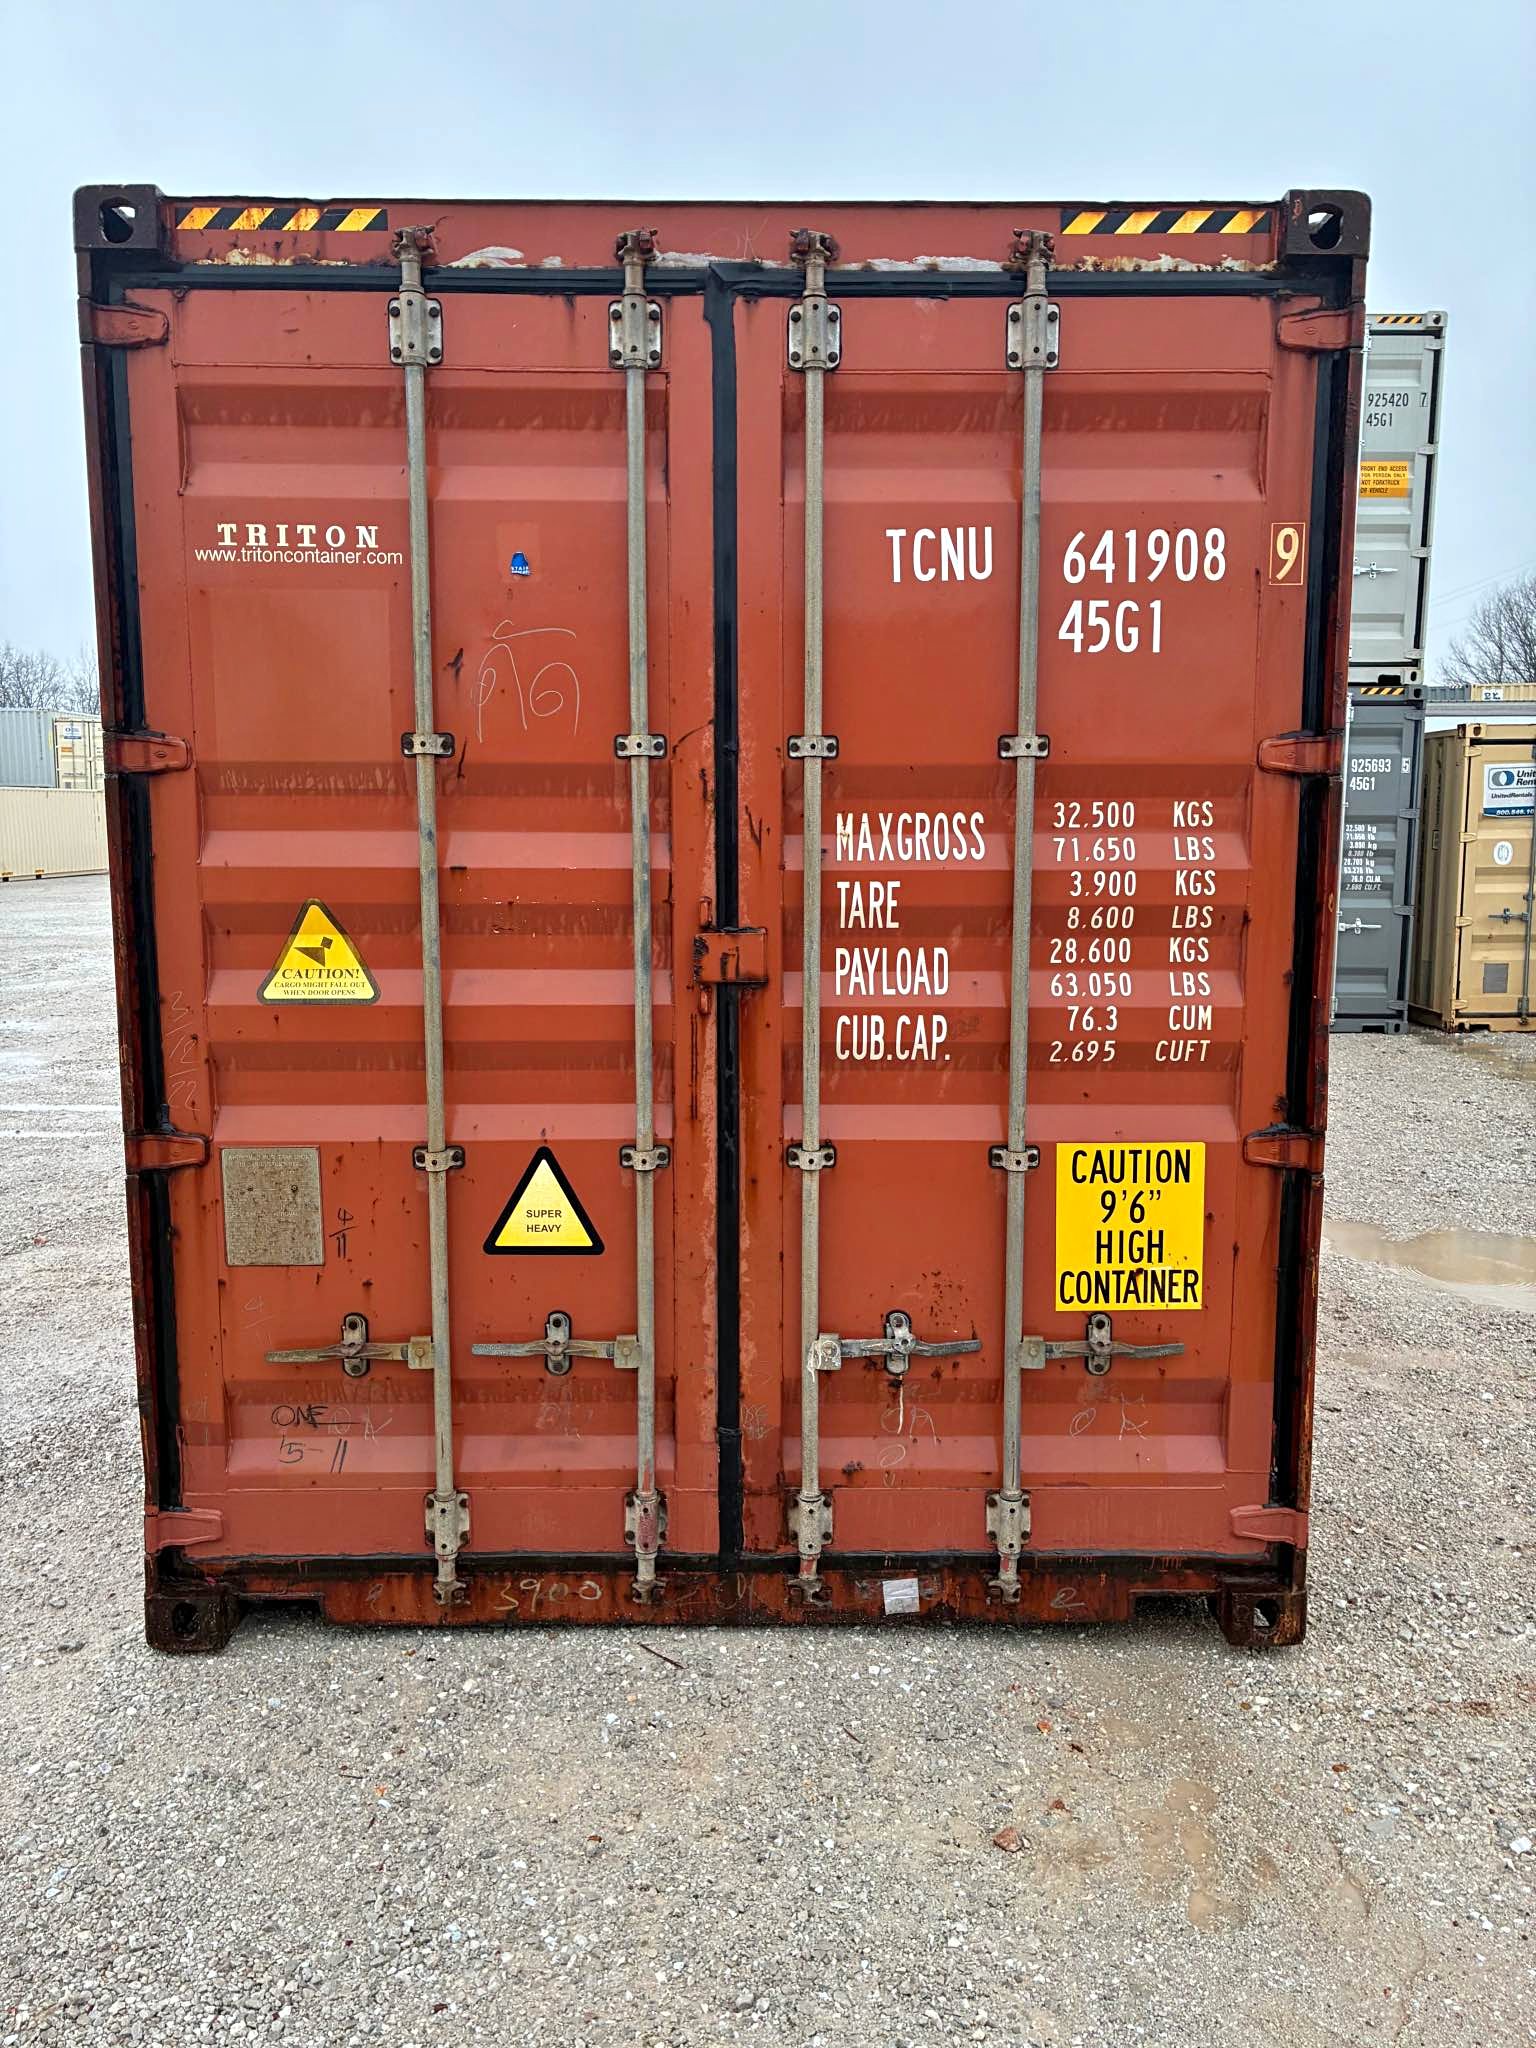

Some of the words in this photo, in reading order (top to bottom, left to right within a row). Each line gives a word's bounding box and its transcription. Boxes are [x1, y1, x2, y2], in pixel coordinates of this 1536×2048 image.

[1367, 393, 1409, 407] 925420
[1420, 392, 1427, 407] 7
[1366, 413, 1393, 427] 45G1
[217, 523, 379, 549] TRITON
[194, 548, 403, 566] www.tritoncontainer.com
[886, 526, 993, 583] TCNU
[1063, 527, 1226, 584] 641908
[1275, 527, 1301, 582] 9
[1058, 599, 1162, 653] 45G1
[1351, 758, 1392, 773] 925693
[1402, 758, 1410, 773] 5
[1350, 777, 1375, 791] 45G1
[1053, 802, 1135, 828] 32,500
[1173, 801, 1214, 828] KGS
[836, 811, 986, 862] MAXGROSS
[1367, 824, 1377, 833] kg
[1052, 837, 1136, 862] 71,650
[1174, 836, 1216, 861] LBS
[1069, 870, 1137, 897] 3,900
[1175, 869, 1216, 896] KGS
[836, 880, 901, 929] TARE
[1066, 906, 1134, 930] 8,600
[1171, 905, 1214, 929] LBS
[1050, 937, 1131, 964] 28,600
[1169, 936, 1209, 963] KGS
[281, 968, 360, 980] CAUTION!
[836, 947, 949, 996] PAYLOAD
[1050, 972, 1132, 997] 63,050
[1169, 971, 1211, 997] LBS
[1067, 1005, 1118, 1031] 76.3
[1168, 1004, 1212, 1031] CUM
[835, 1014, 950, 1061] CUB.CAP.
[1049, 1040, 1116, 1062] 2,695
[1155, 1039, 1211, 1062] CUFT
[1071, 1149, 1191, 1184] CAUTION
[526, 1209, 562, 1219] SUPER
[526, 1225, 562, 1233] HEAVY
[1096, 1230, 1164, 1265] HIGH
[1059, 1268, 1199, 1305] CONTAINER
